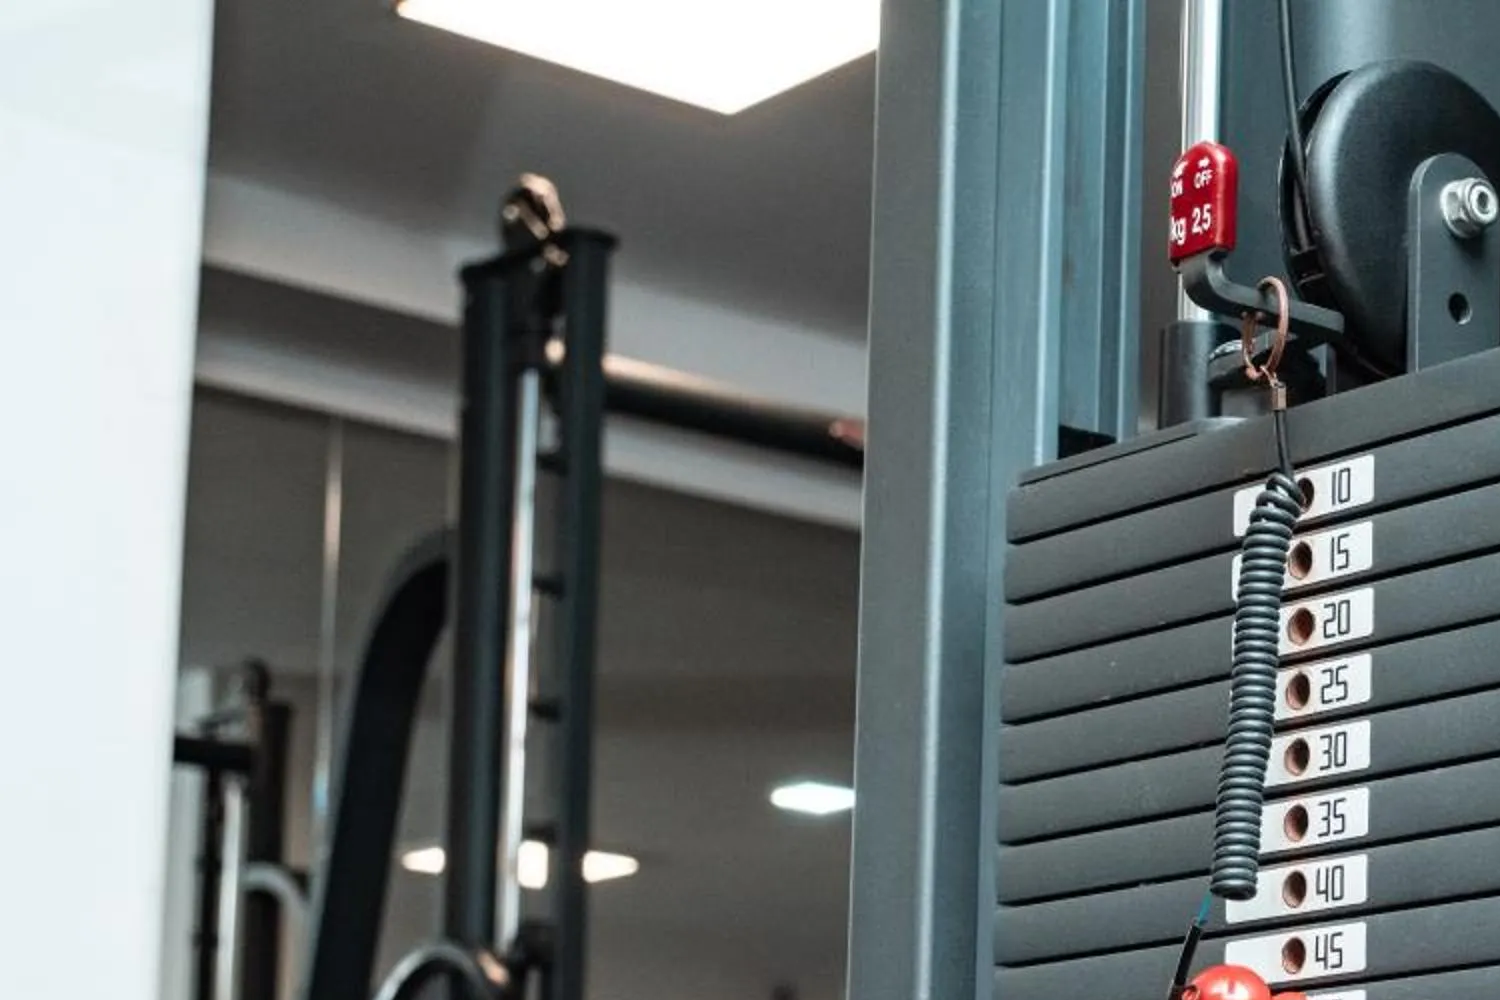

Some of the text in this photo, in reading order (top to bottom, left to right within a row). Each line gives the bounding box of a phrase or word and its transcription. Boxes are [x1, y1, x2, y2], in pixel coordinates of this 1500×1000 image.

[1193, 168, 1213, 189] OFF
[1171, 215, 1187, 246] kg
[1332, 468, 1350, 505] 10
[1331, 534, 1349, 571] 15
[1324, 600, 1350, 638] 20
[1321, 665, 1348, 704] 25
[1320, 732, 1347, 770] 30
[1318, 798, 1345, 837] 35
[1316, 866, 1344, 902] 40
[1316, 932, 1342, 969] 45
